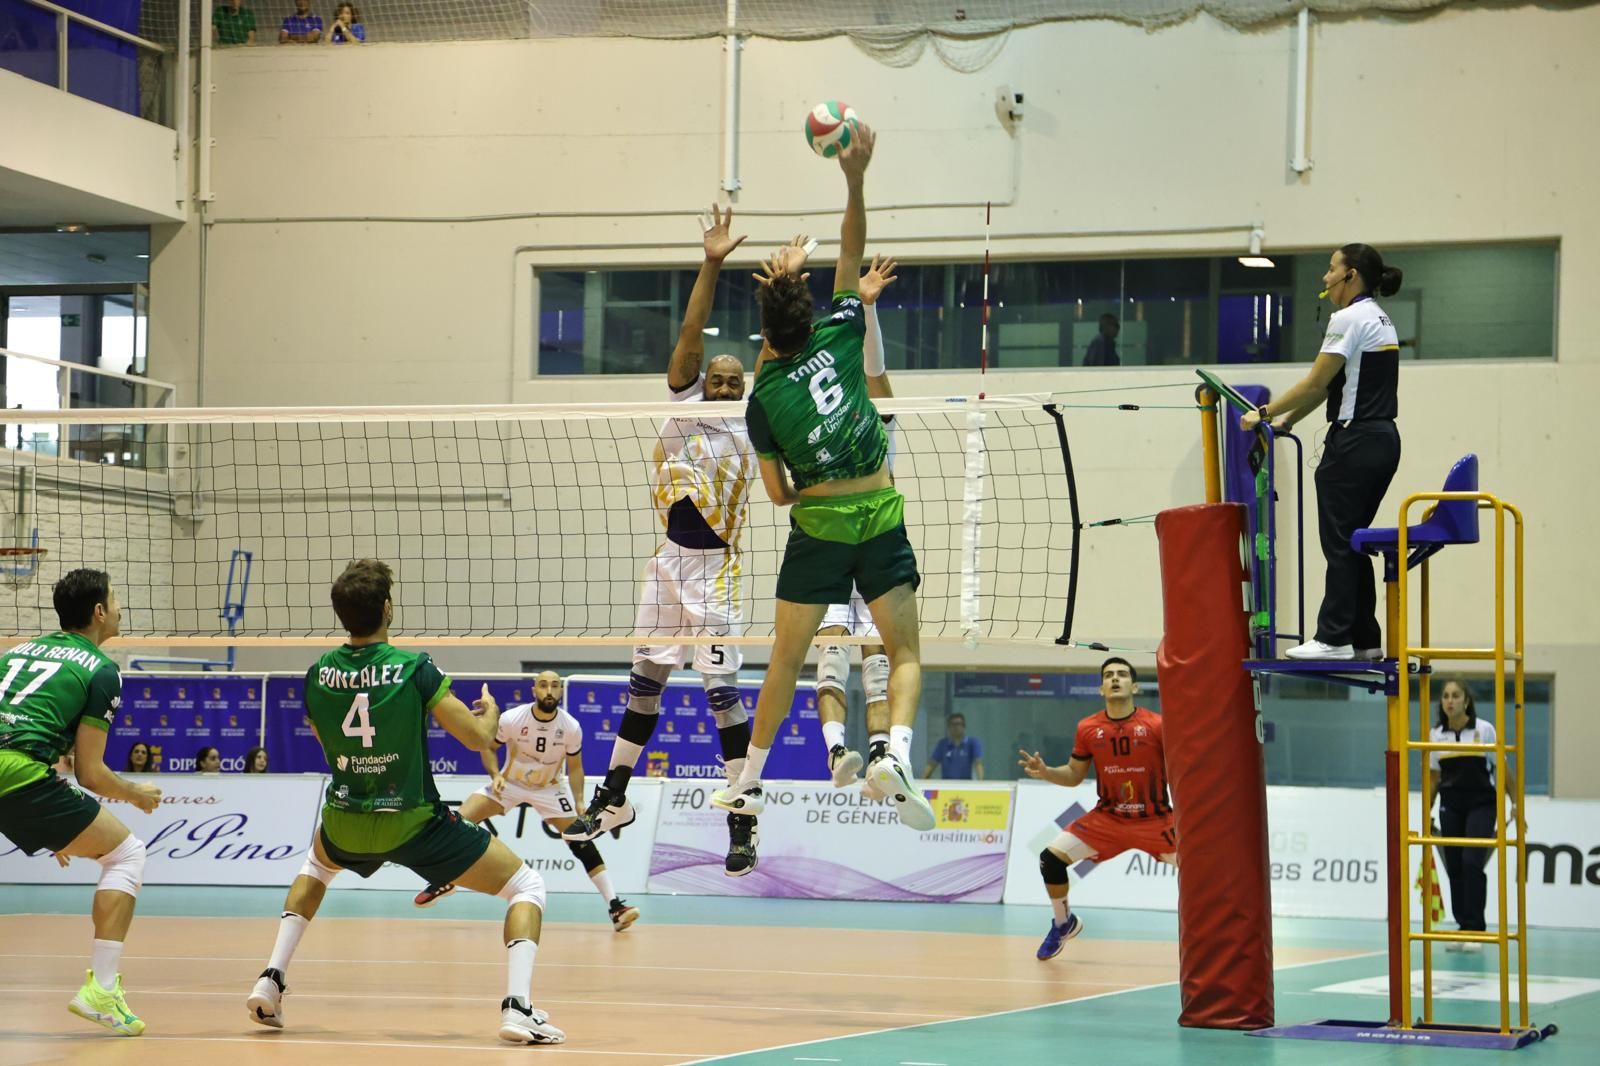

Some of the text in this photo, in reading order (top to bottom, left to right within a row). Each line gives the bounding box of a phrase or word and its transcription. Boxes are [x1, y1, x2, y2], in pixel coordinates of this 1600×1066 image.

[808, 367, 844, 415] 6
[44, 645, 101, 672] RENAN
[711, 644, 724, 664] 5
[0, 658, 62, 705] 17
[318, 663, 404, 689] GONZÁLEZ
[341, 693, 376, 747] 4
[536, 737, 546, 752] 8
[1111, 736, 1131, 756] 10
[351, 753, 400, 765] Fundación
[352, 764, 387, 774] Unicaja
[558, 798, 573, 812] 8
[764, 791, 794, 805] NO
[806, 807, 899, 825] DE GÉNER
[1161, 828, 1176, 847] 1
[1312, 858, 1379, 883] 2005
